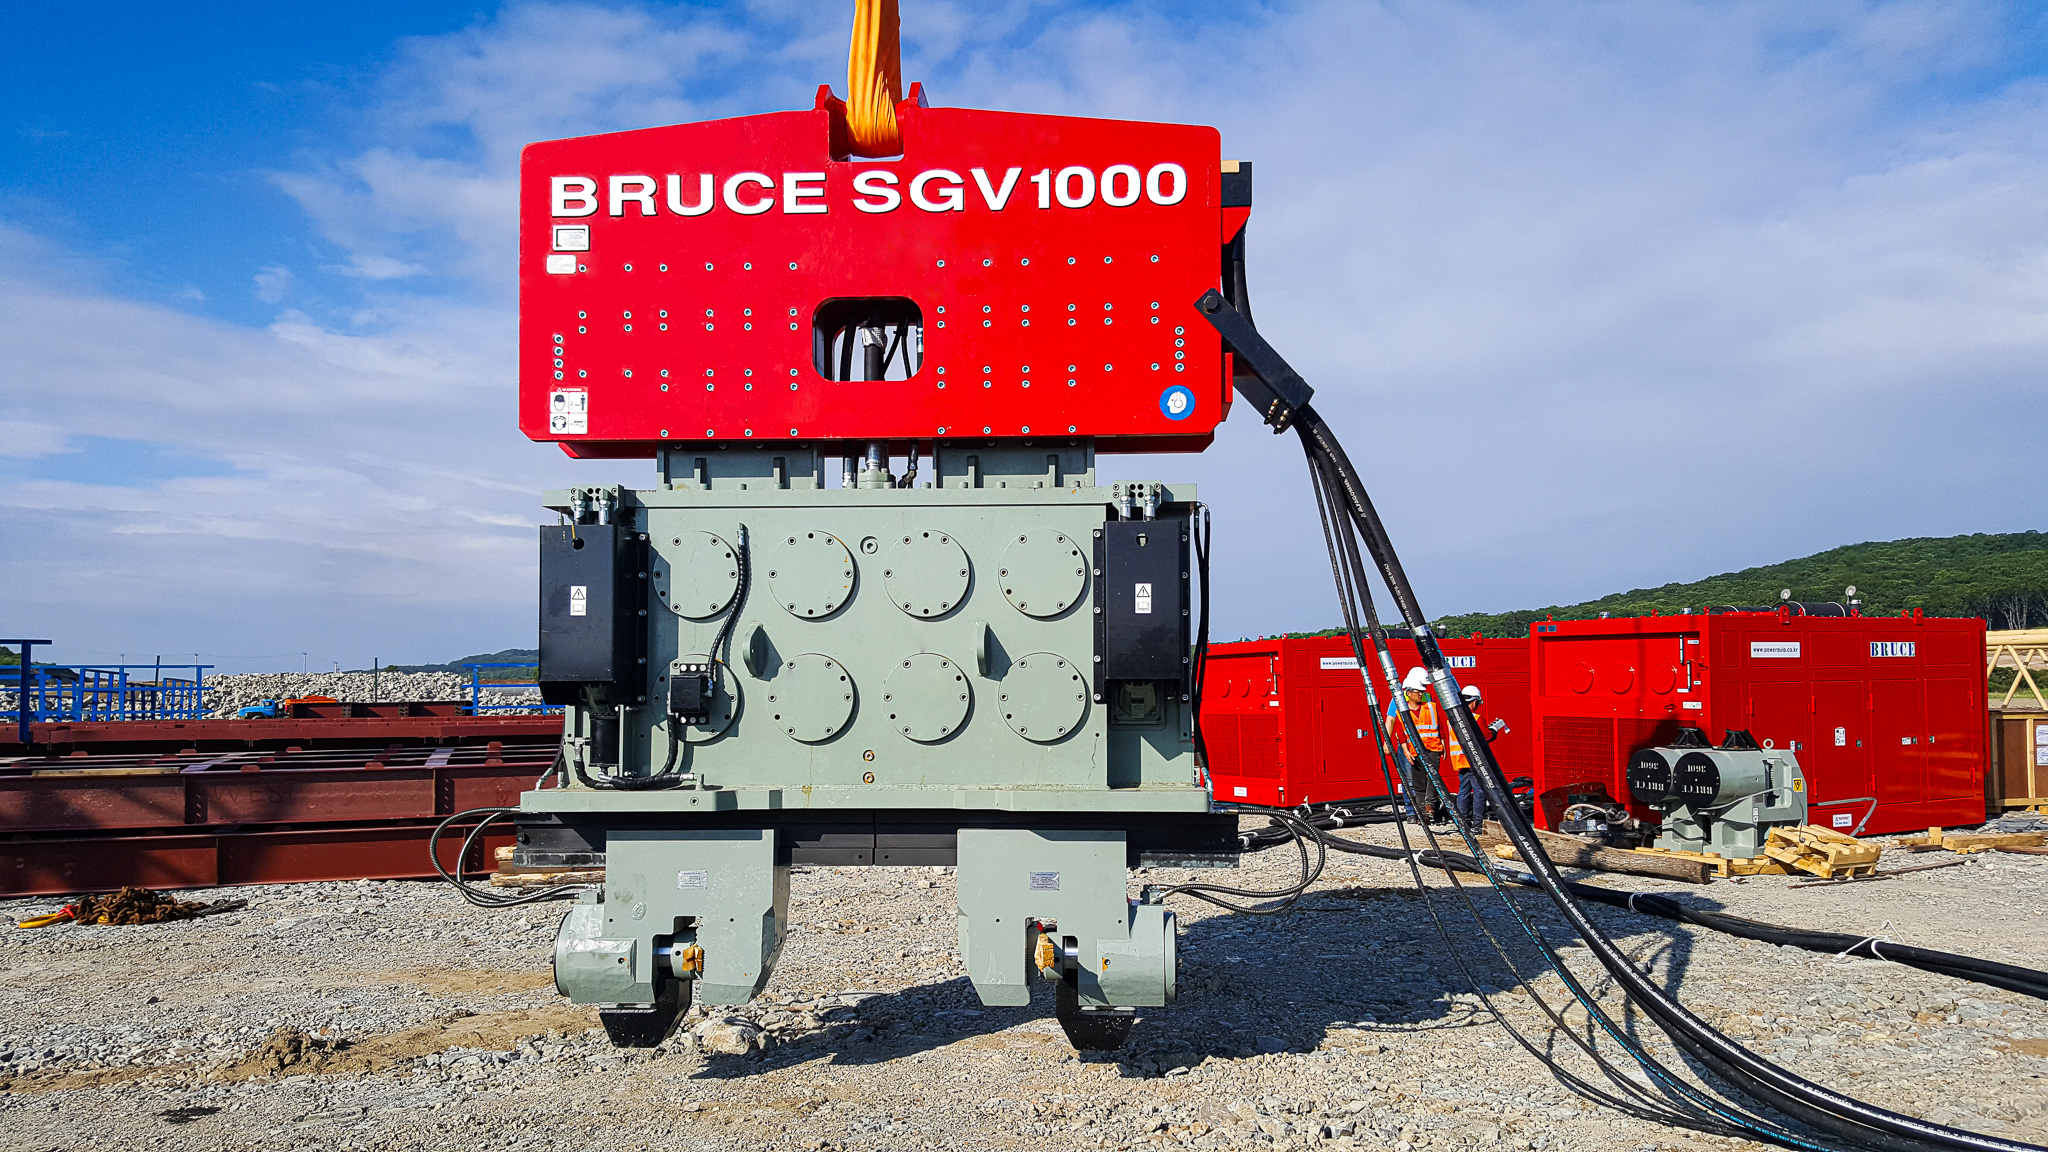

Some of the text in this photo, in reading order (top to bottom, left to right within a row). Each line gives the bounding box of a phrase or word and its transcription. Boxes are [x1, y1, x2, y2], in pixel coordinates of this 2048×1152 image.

[550, 163, 1188, 217] BRUCE SGV1000
[1870, 642, 1916, 657] BRUCE
[1634, 780, 1664, 791] BRUCE
[1681, 784, 1713, 795] BRUCE
[1520, 839, 1550, 877] ALFAGOMMA
